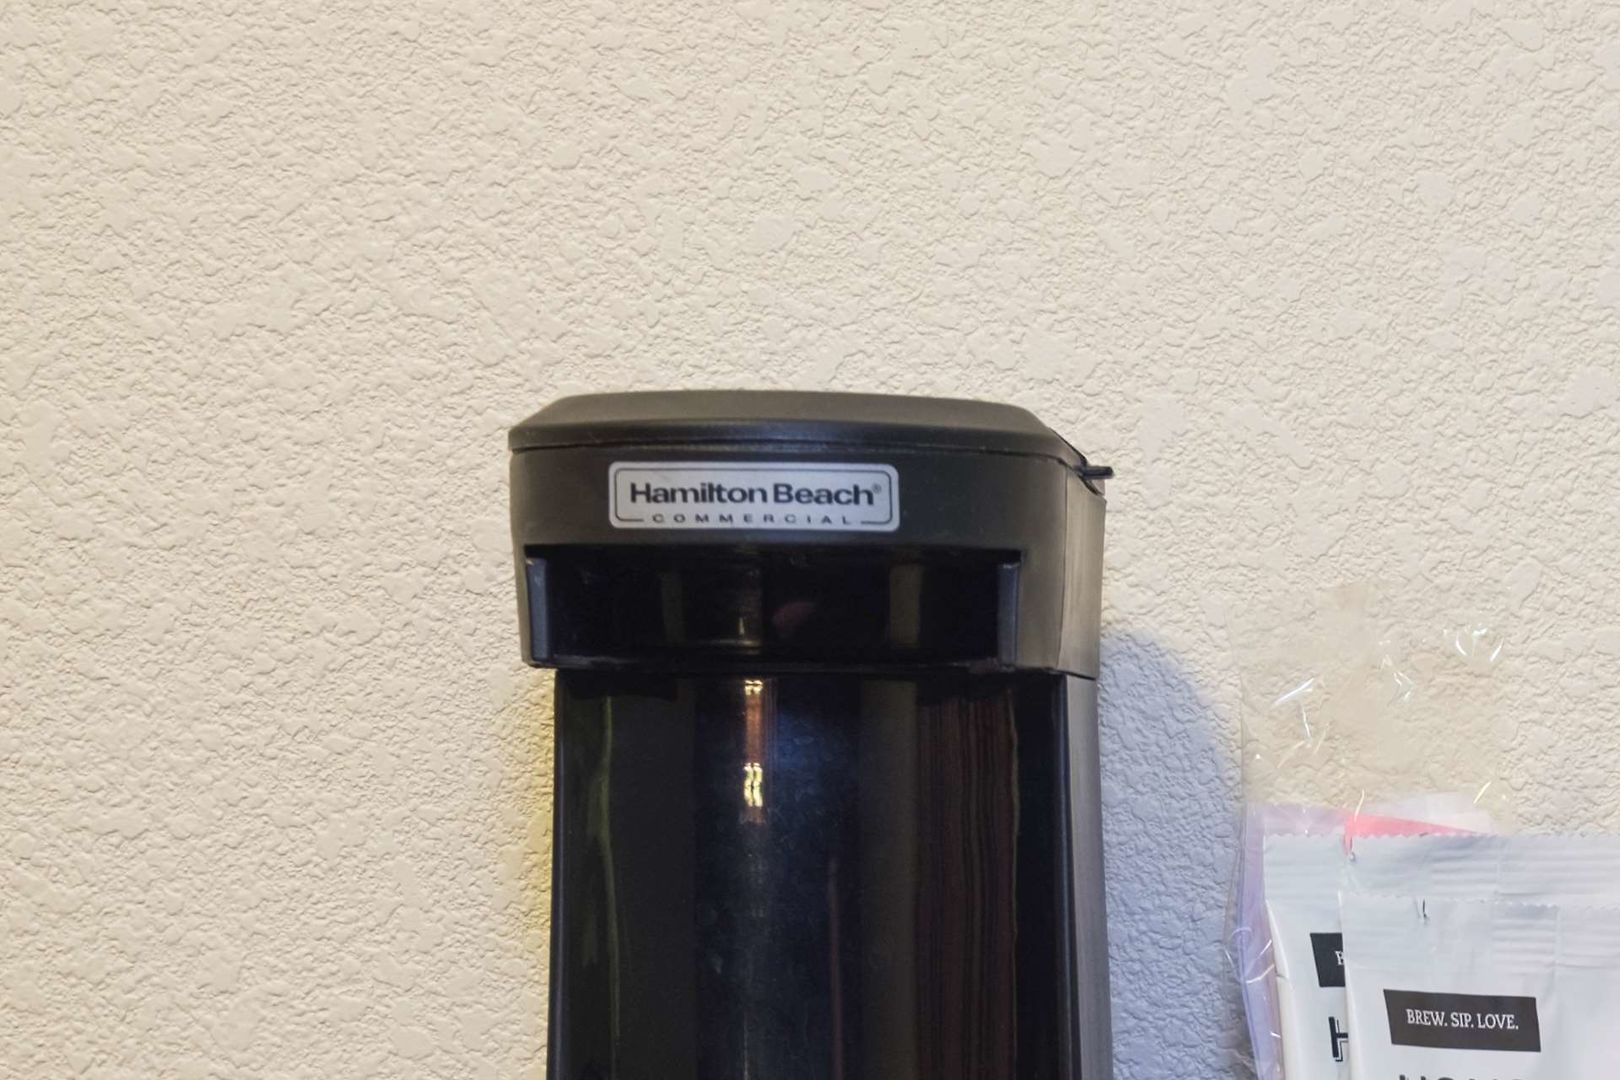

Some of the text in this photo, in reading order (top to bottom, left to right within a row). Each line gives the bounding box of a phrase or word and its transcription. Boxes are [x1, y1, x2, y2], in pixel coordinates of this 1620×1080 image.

[630, 482, 767, 504] Hamilton
[652, 513, 854, 526] COMMERCIAL
[1405, 1008, 1519, 1030] BREW. SIP. LOVE.
